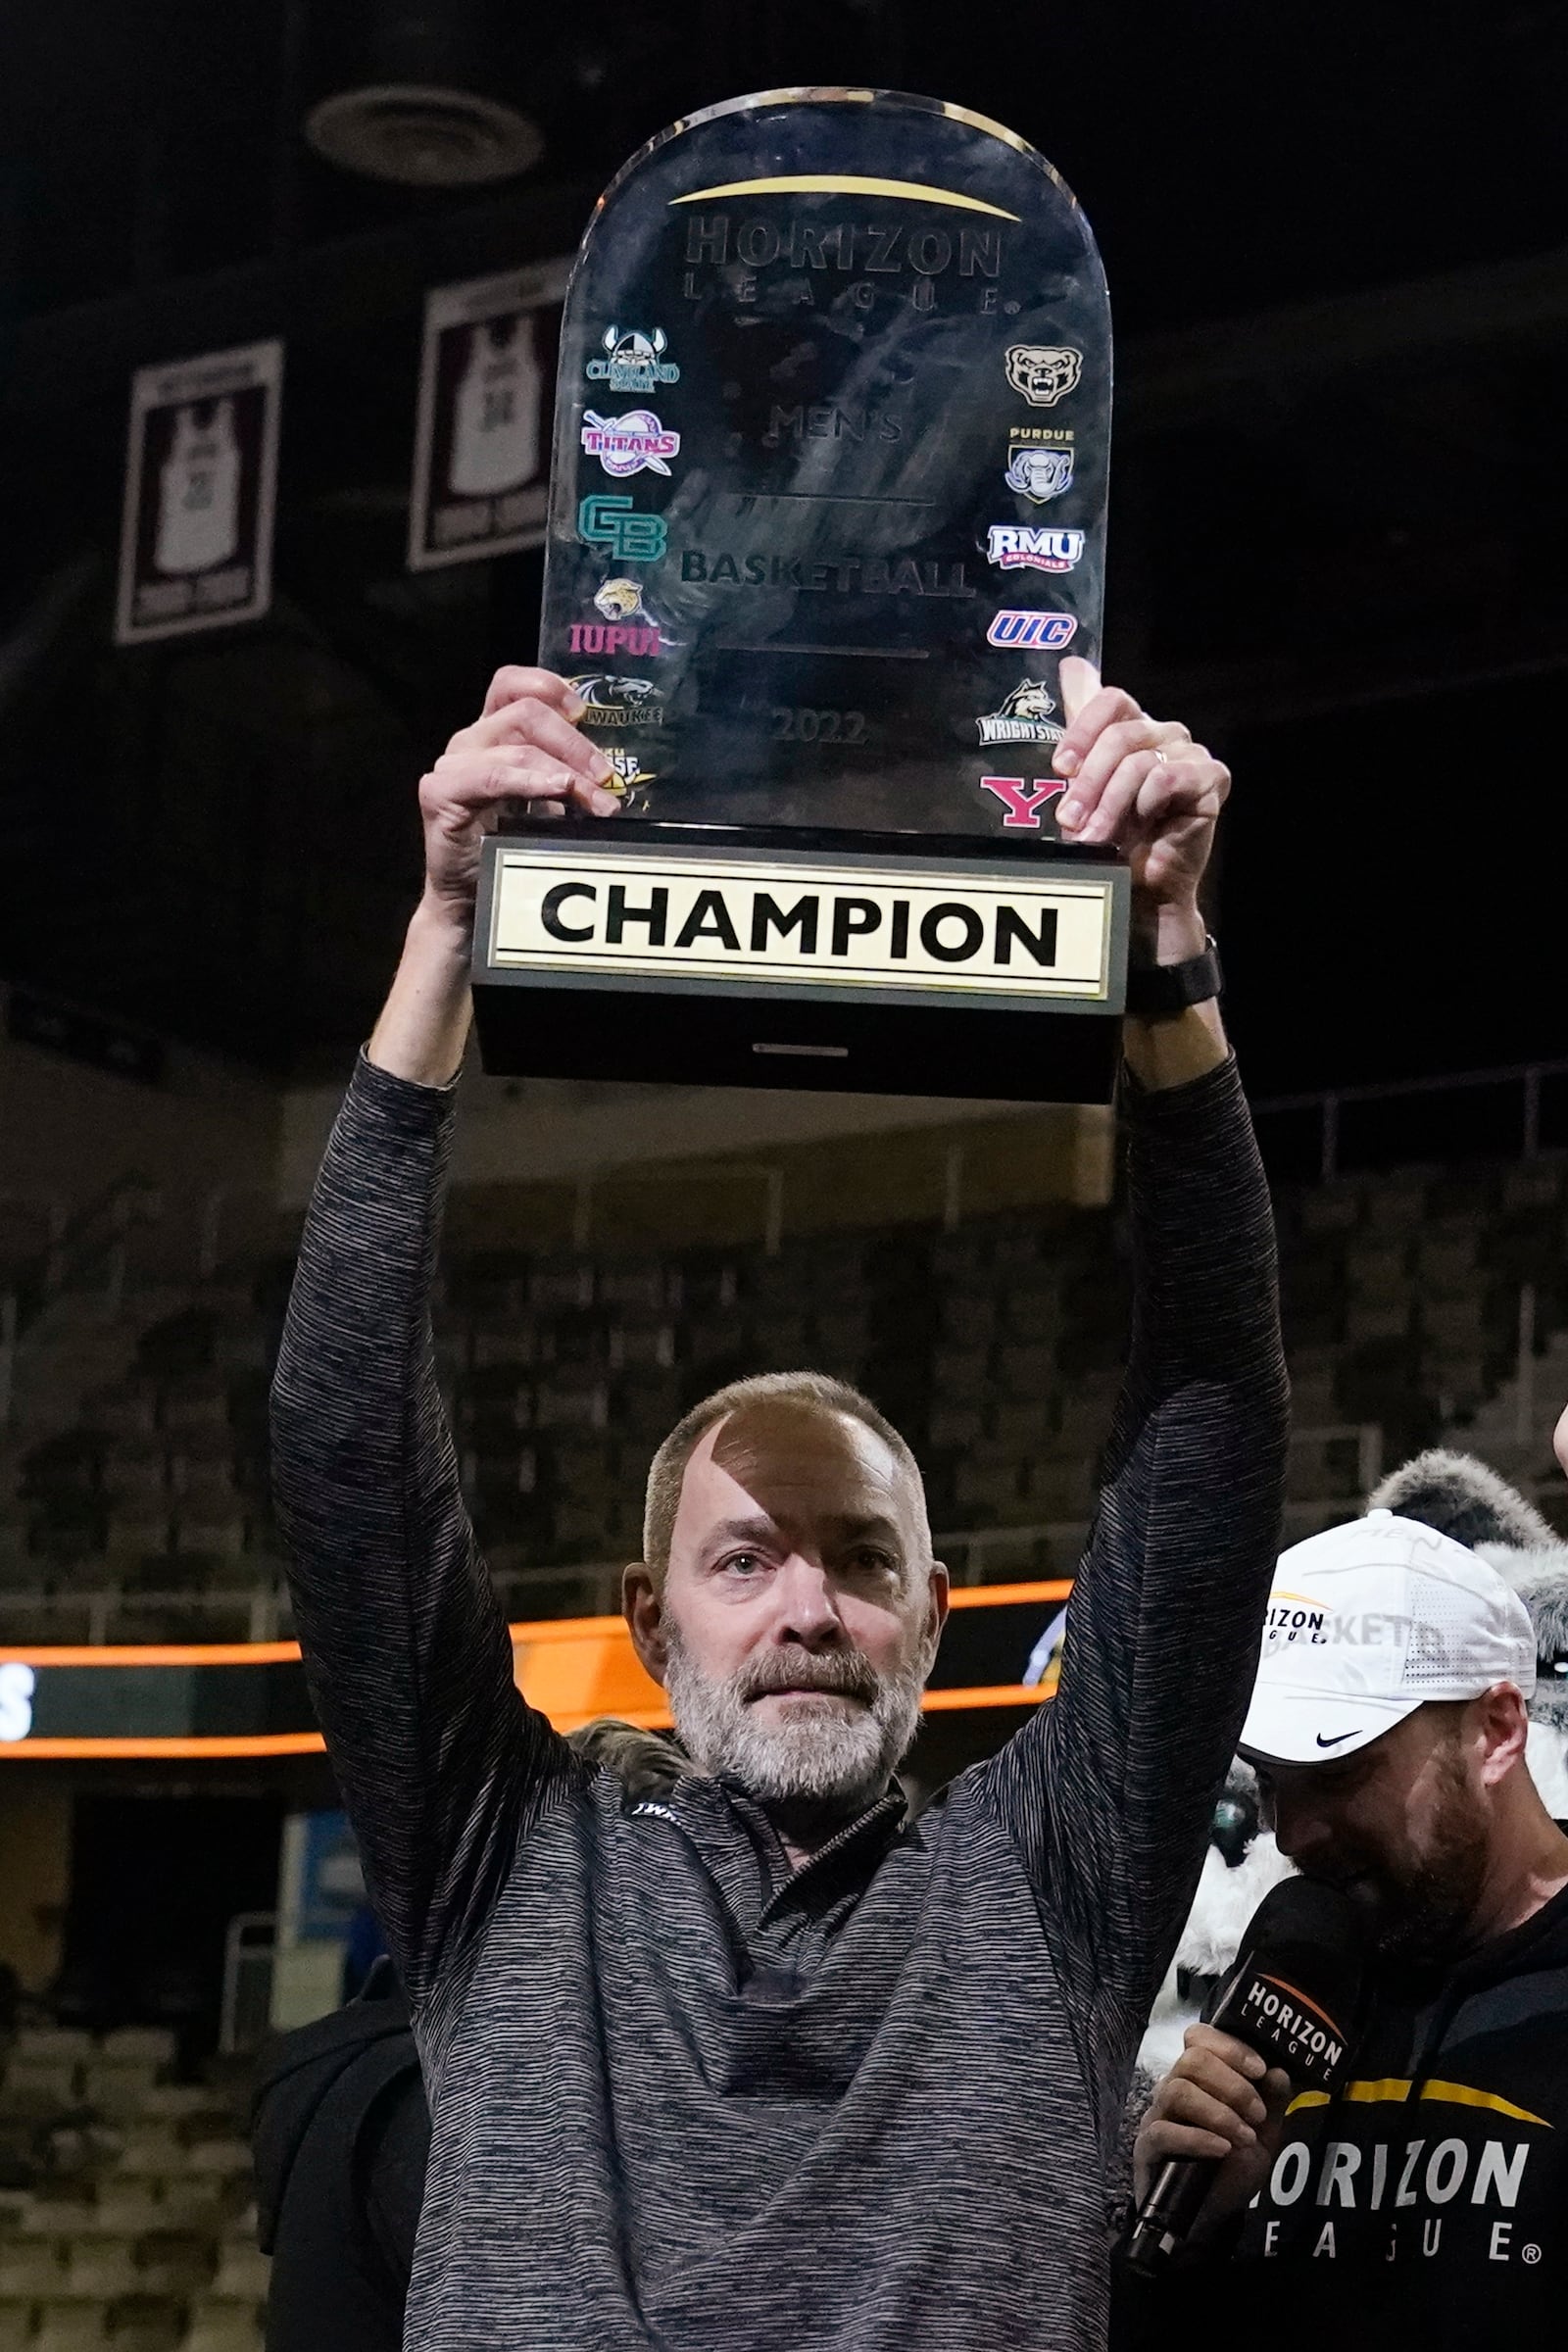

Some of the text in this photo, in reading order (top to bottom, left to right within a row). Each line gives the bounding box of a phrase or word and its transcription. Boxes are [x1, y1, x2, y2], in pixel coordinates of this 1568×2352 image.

[683, 214, 1002, 278] HORIZON
[586, 432, 675, 453] TITANS
[1009, 427, 1075, 441] PURDUE
[990, 528, 1081, 561] RMU
[681, 549, 977, 599] BASKETBALL
[568, 623, 662, 658] IUPUI
[993, 616, 1070, 643] UIC
[769, 706, 867, 745] 2022
[980, 718, 1037, 742] WRIGHT
[980, 775, 1067, 828] Y
[540, 881, 1059, 967] CHAMPION
[1240, 2007, 1334, 2082] LEAGUE
[1247, 1981, 1344, 2068] HORIZON
[1249, 2137, 1531, 2211] ORIZON
